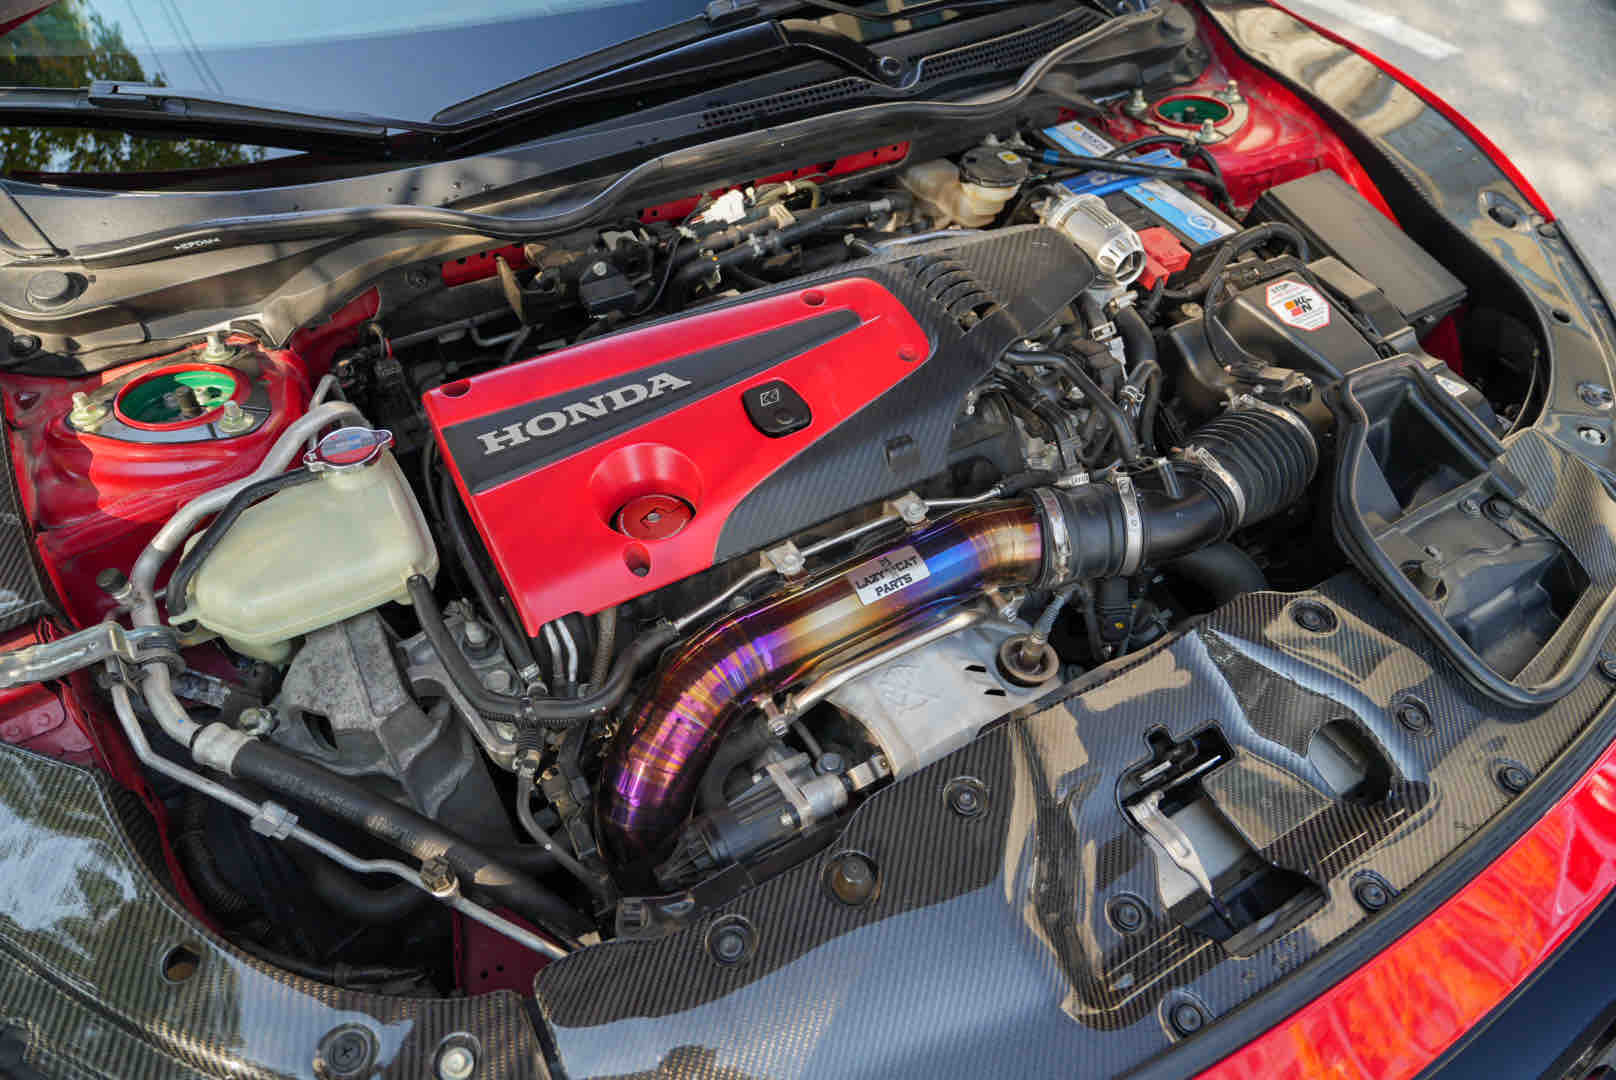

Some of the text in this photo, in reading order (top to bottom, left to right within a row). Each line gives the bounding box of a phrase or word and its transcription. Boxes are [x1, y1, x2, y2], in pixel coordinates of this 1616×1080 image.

[477, 372, 692, 455] HONDA
[856, 571, 885, 589] LAZY
[875, 572, 913, 597] PARTS
